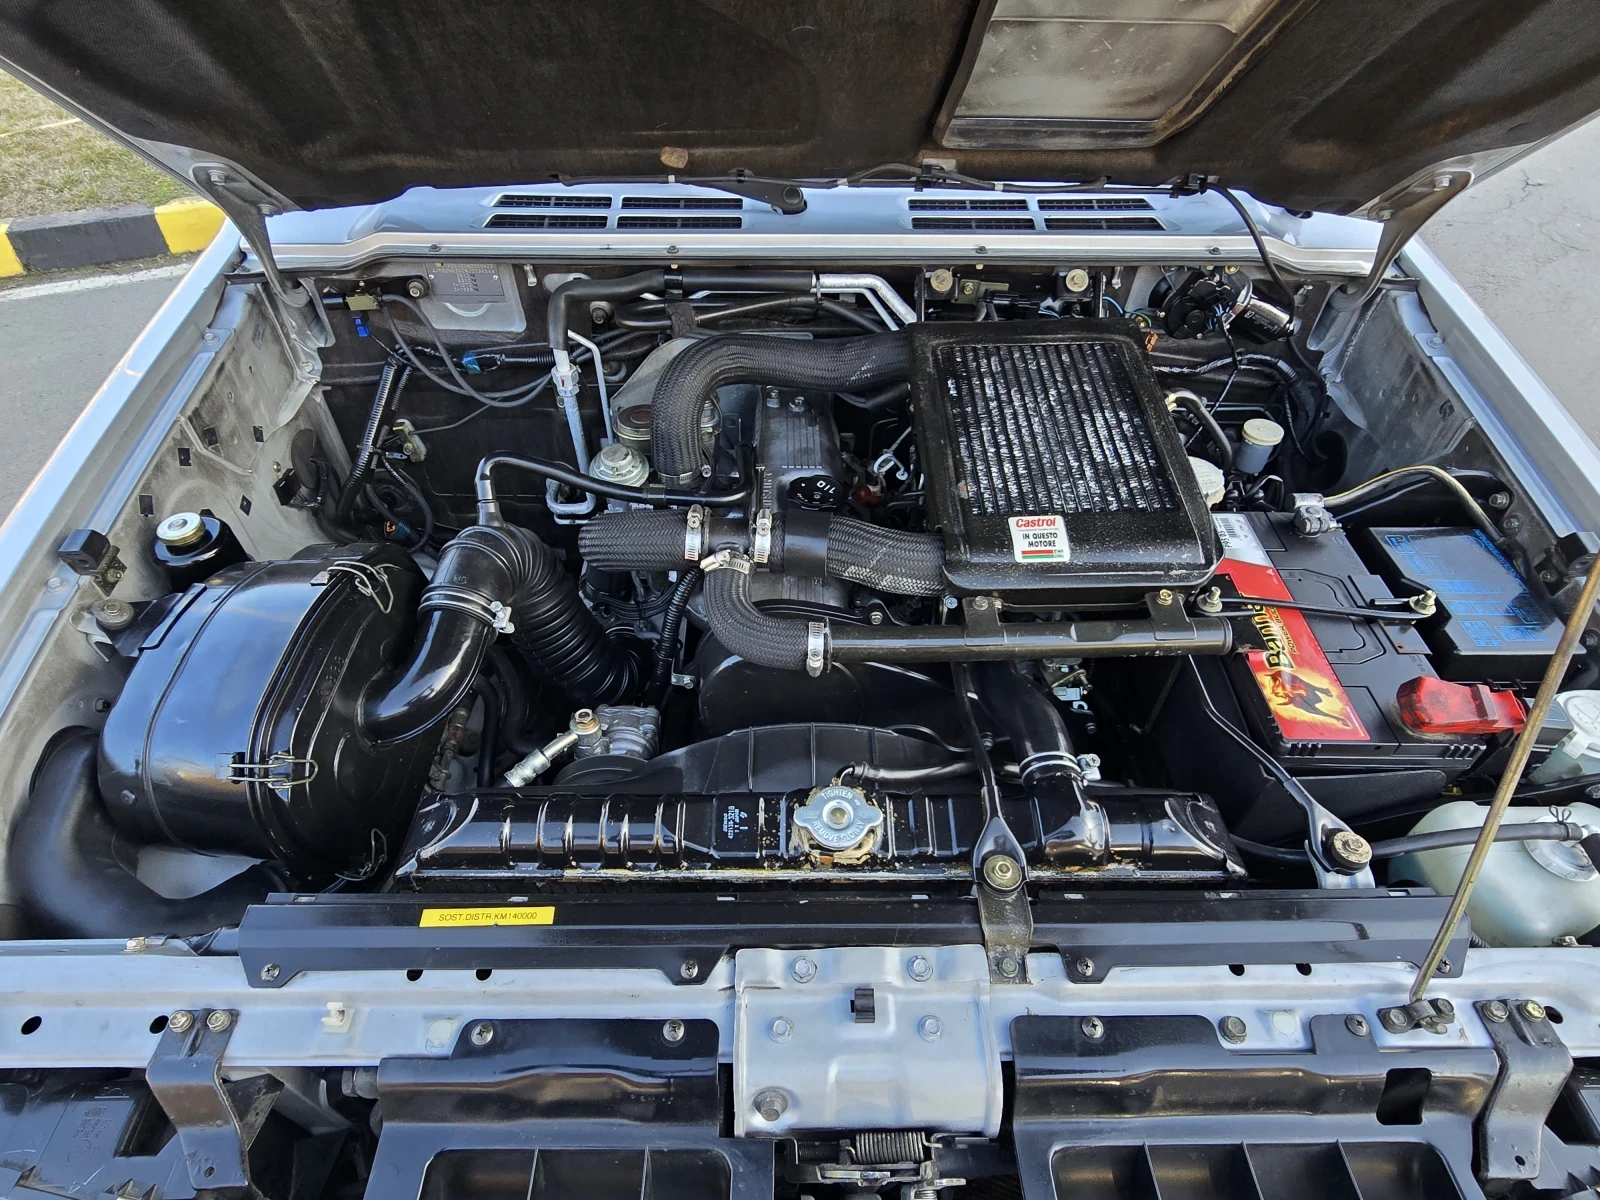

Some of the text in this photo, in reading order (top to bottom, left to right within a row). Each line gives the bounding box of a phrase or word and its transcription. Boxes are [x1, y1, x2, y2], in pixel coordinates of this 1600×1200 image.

[816, 480, 836, 494] OIL
[1016, 517, 1056, 528] Castrol
[1032, 532, 1058, 540] QUESTO
[1027, 540, 1056, 548] MOTORE
[1279, 624, 1298, 654] POWER
[821, 788, 853, 800] TIGHTEN
[812, 820, 865, 842] REMOVE SLOWLY
[438, 911, 537, 922] SOST.DISTR.KM140000
